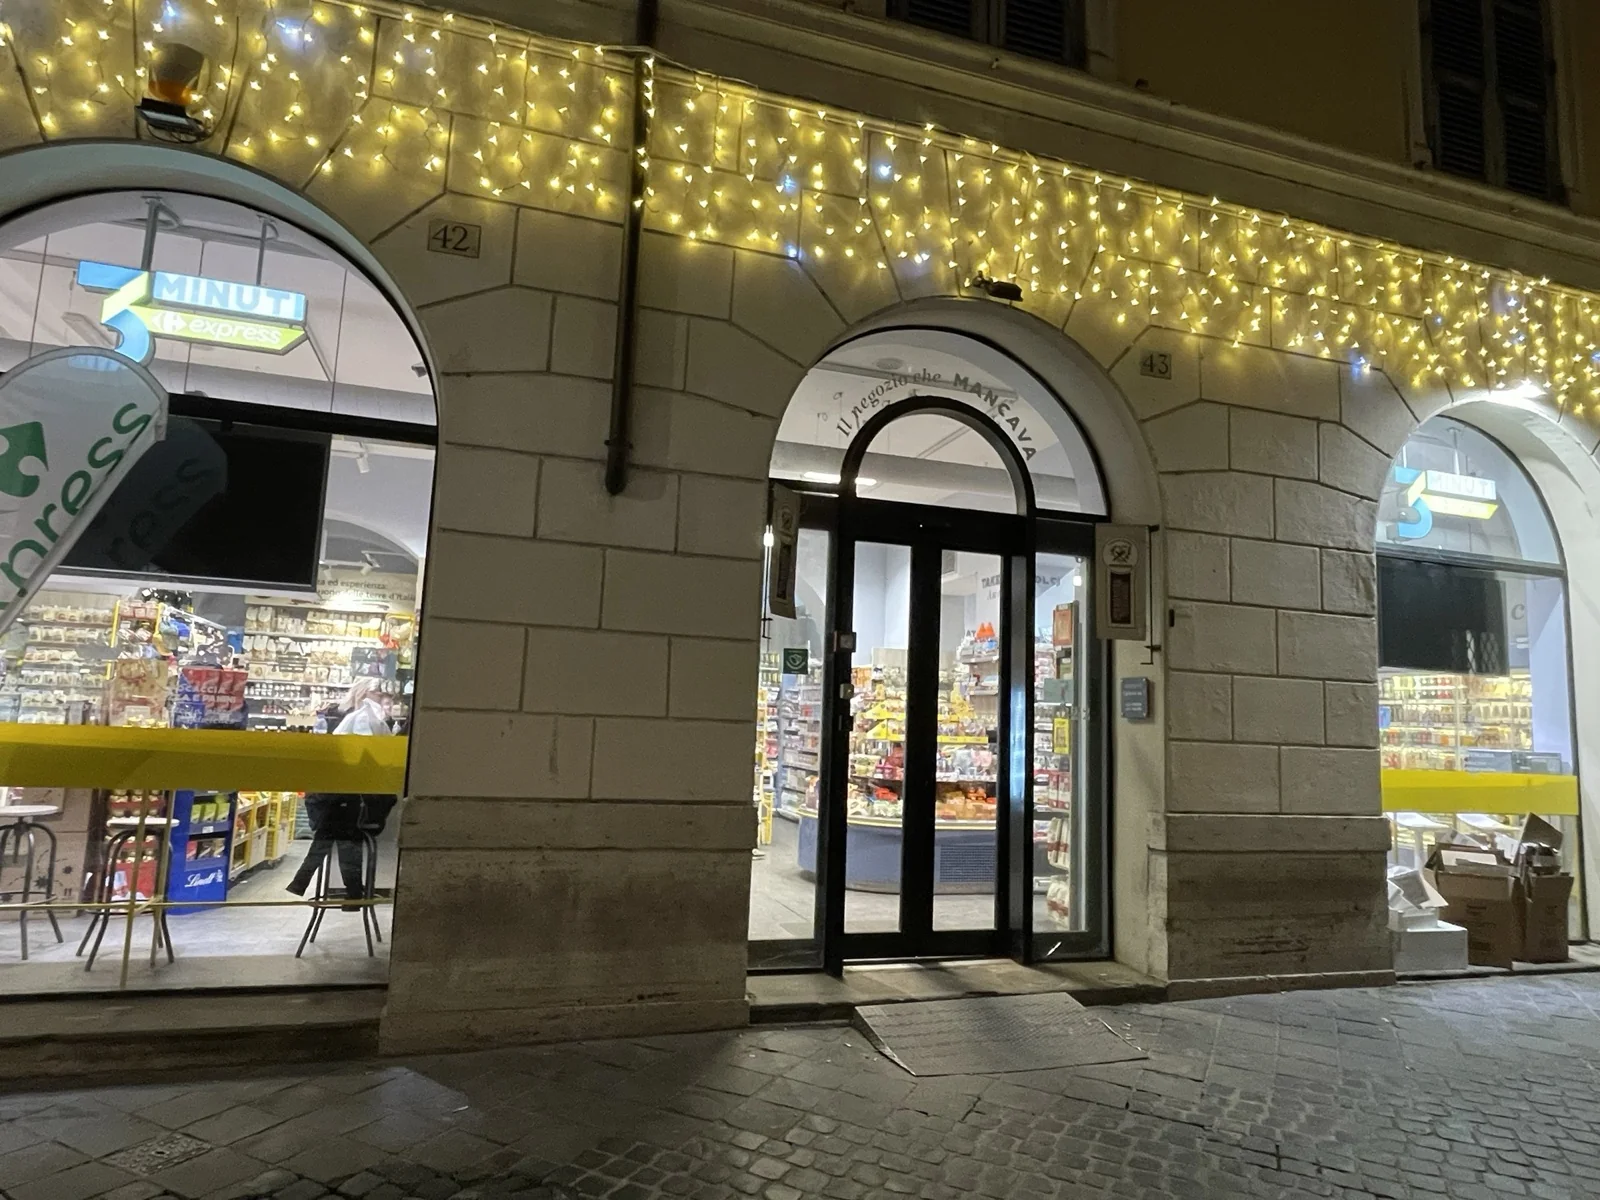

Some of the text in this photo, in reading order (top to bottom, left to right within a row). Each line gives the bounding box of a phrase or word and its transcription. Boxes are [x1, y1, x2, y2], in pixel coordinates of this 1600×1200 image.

[432, 225, 470, 252] 42
[156, 273, 305, 320] MINUTI
[189, 316, 281, 345] express
[1142, 354, 1169, 374] 43
[836, 367, 1037, 461] Il negozio che MANCAVA
